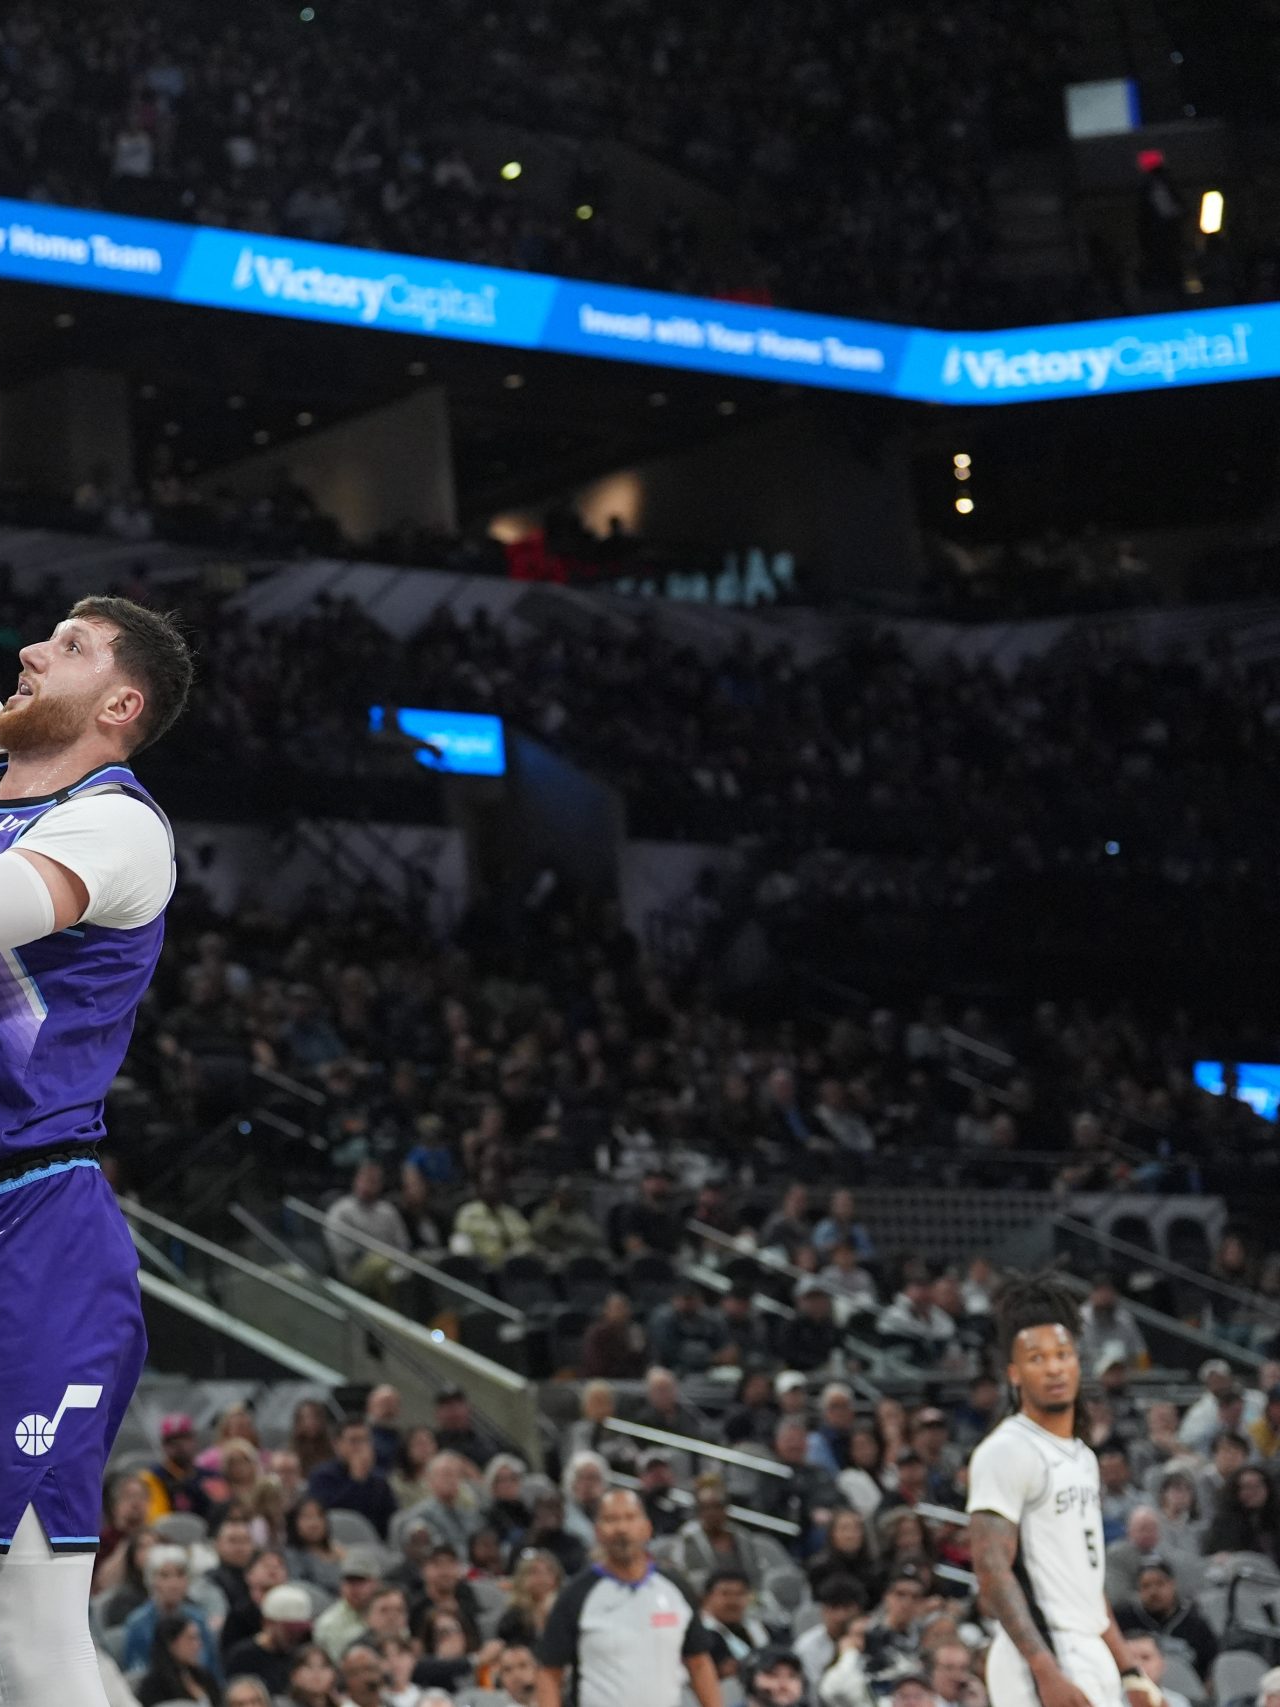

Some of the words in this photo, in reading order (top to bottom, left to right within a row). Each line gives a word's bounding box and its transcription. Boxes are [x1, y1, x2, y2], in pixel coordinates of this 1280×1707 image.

[9, 223, 90, 265] Home
[89, 234, 162, 275] Team
[1084, 1528, 1098, 1569] 5
